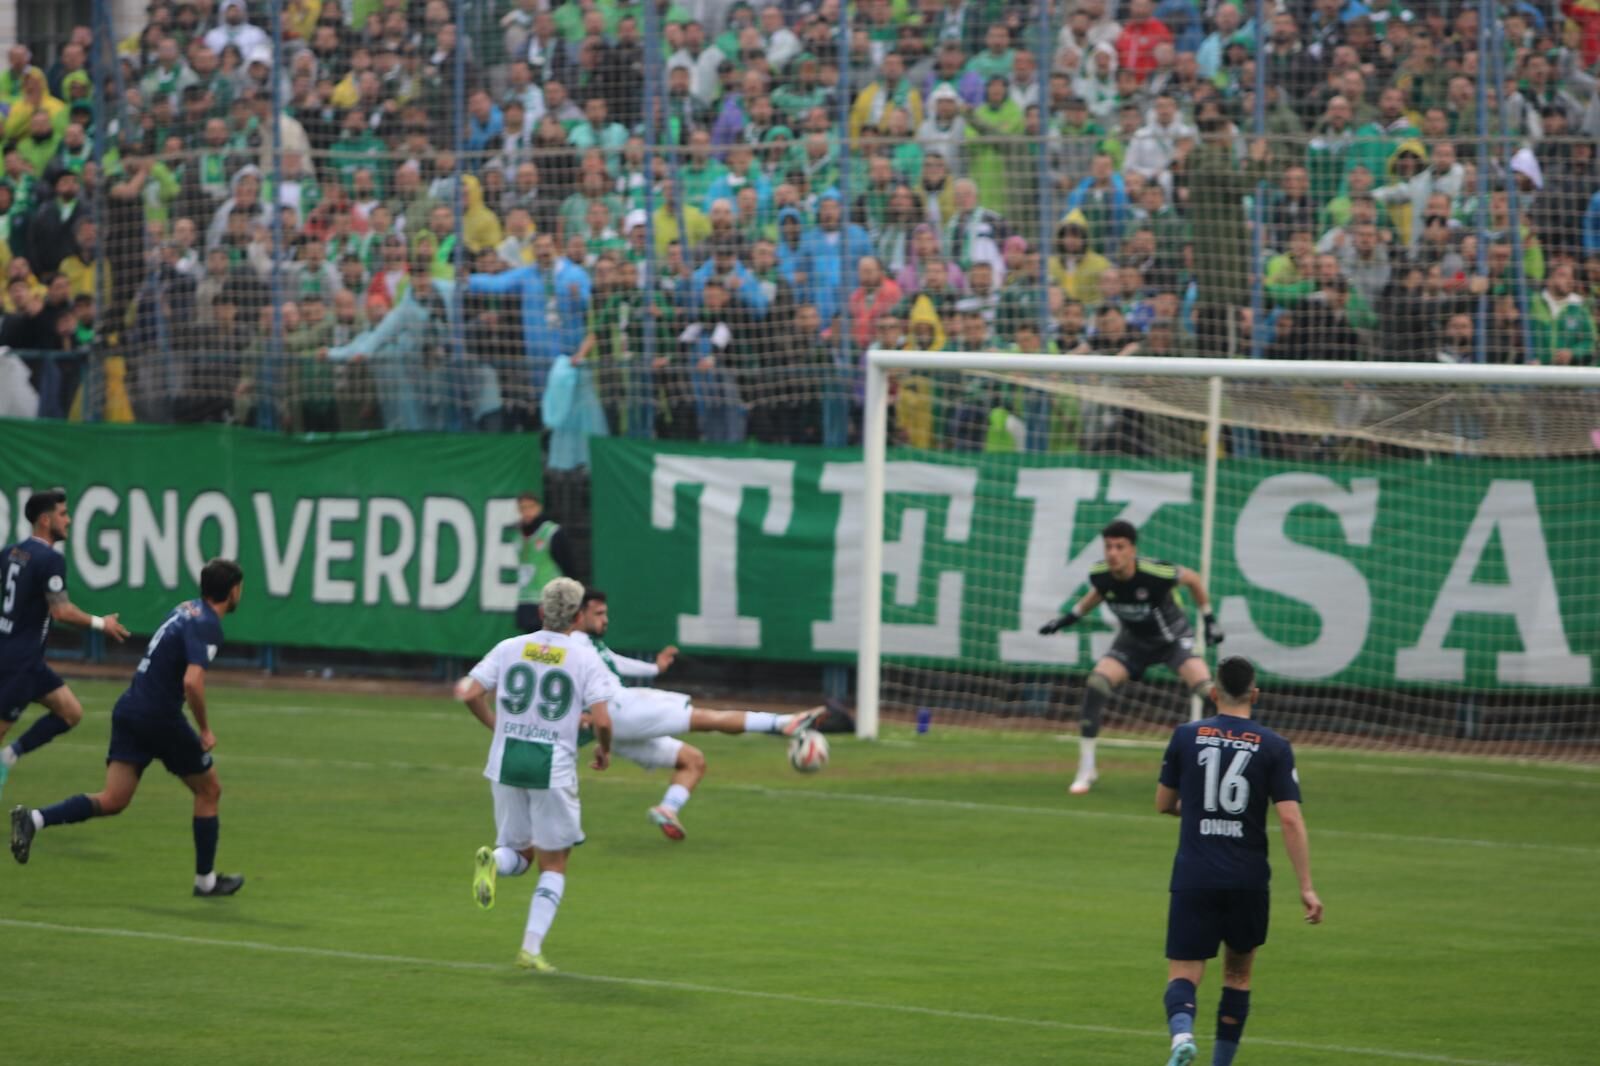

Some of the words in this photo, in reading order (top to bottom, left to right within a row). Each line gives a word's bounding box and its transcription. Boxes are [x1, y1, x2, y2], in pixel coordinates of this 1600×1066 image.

[0, 485, 238, 590] GNO
[253, 491, 520, 612] VERDE
[651, 454, 1591, 686] TEKSA
[3, 562, 20, 614] 5
[500, 662, 575, 721] 99
[1195, 736, 1259, 752] BETON
[1197, 746, 1251, 814] 16
[1199, 818, 1243, 837] ONUR
